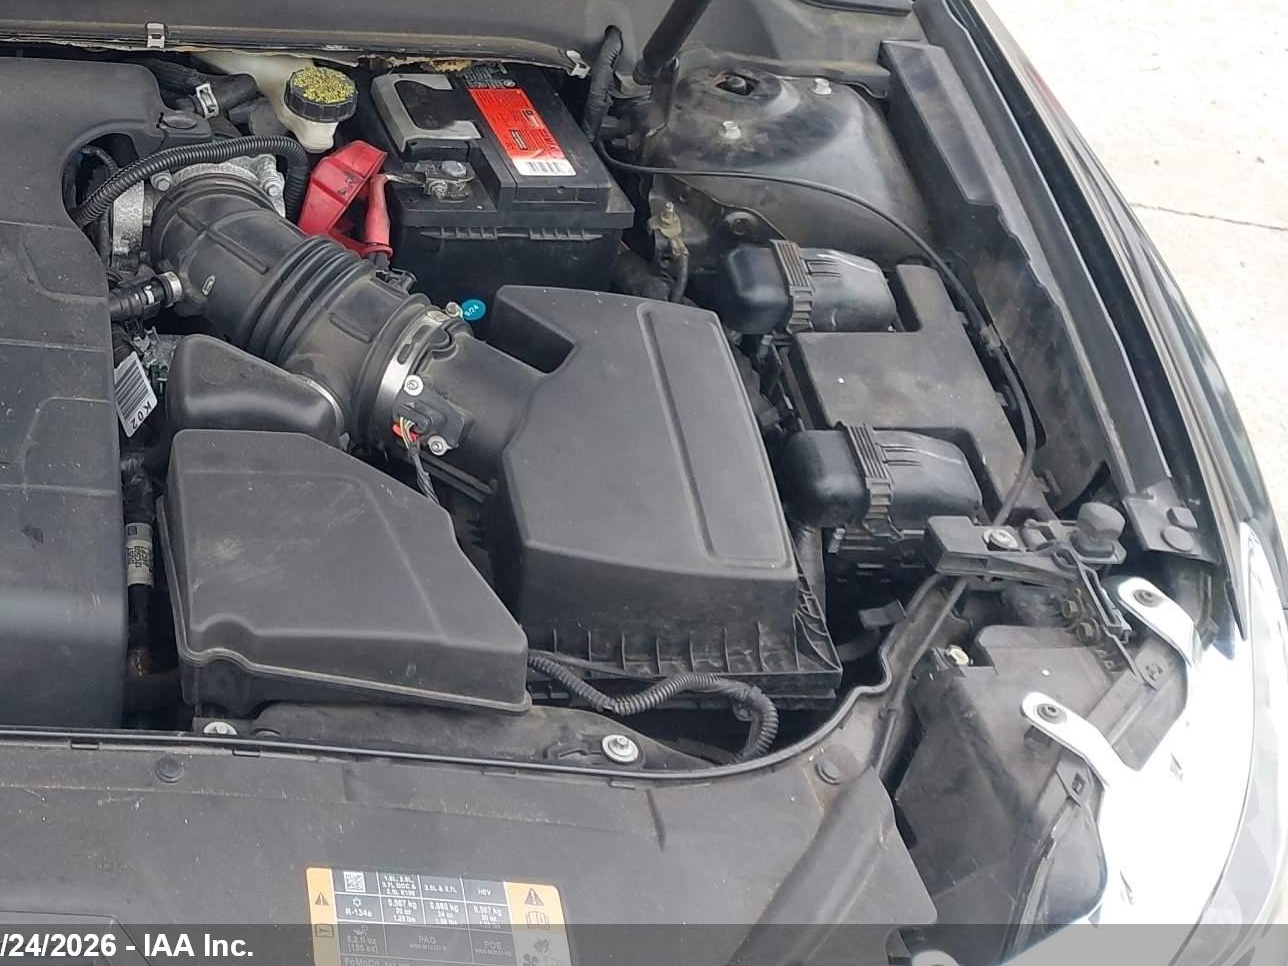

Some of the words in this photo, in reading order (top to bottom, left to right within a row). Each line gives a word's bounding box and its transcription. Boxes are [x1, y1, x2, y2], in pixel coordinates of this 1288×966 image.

[131, 401, 152, 429] K02
[407, 900, 417, 910] kg
[345, 907, 372, 917] R-134a
[367, 937, 376, 945] oz
[418, 935, 437, 945] PAG
[483, 940, 502, 950] POE
